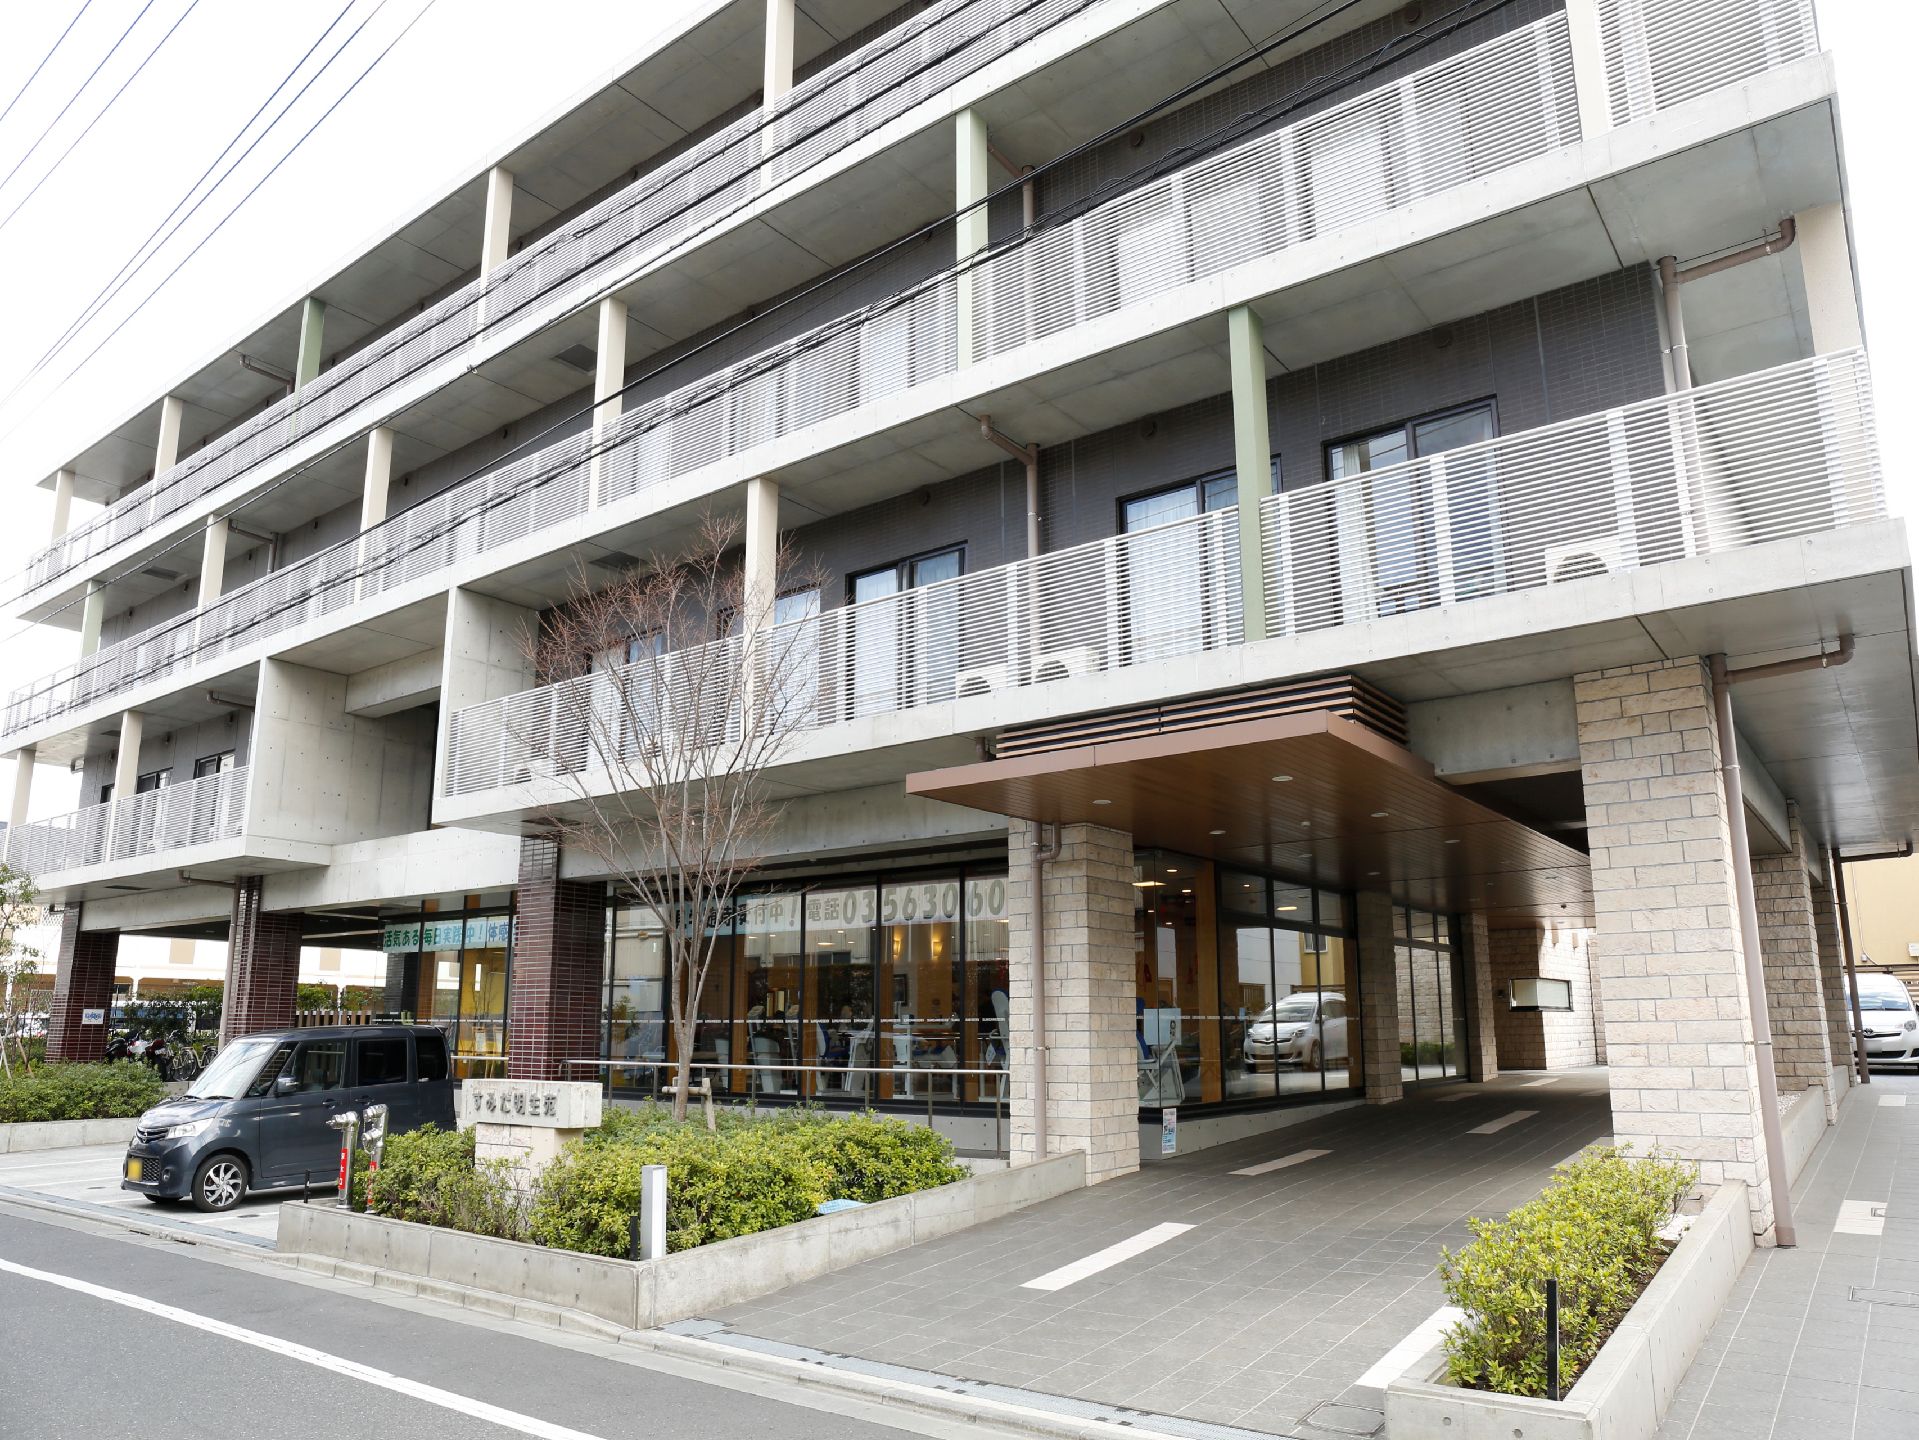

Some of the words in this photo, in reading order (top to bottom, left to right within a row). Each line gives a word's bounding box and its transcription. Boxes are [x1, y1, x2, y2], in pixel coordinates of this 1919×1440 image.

[472, 1092, 557, 1117] すみだ明生苑
